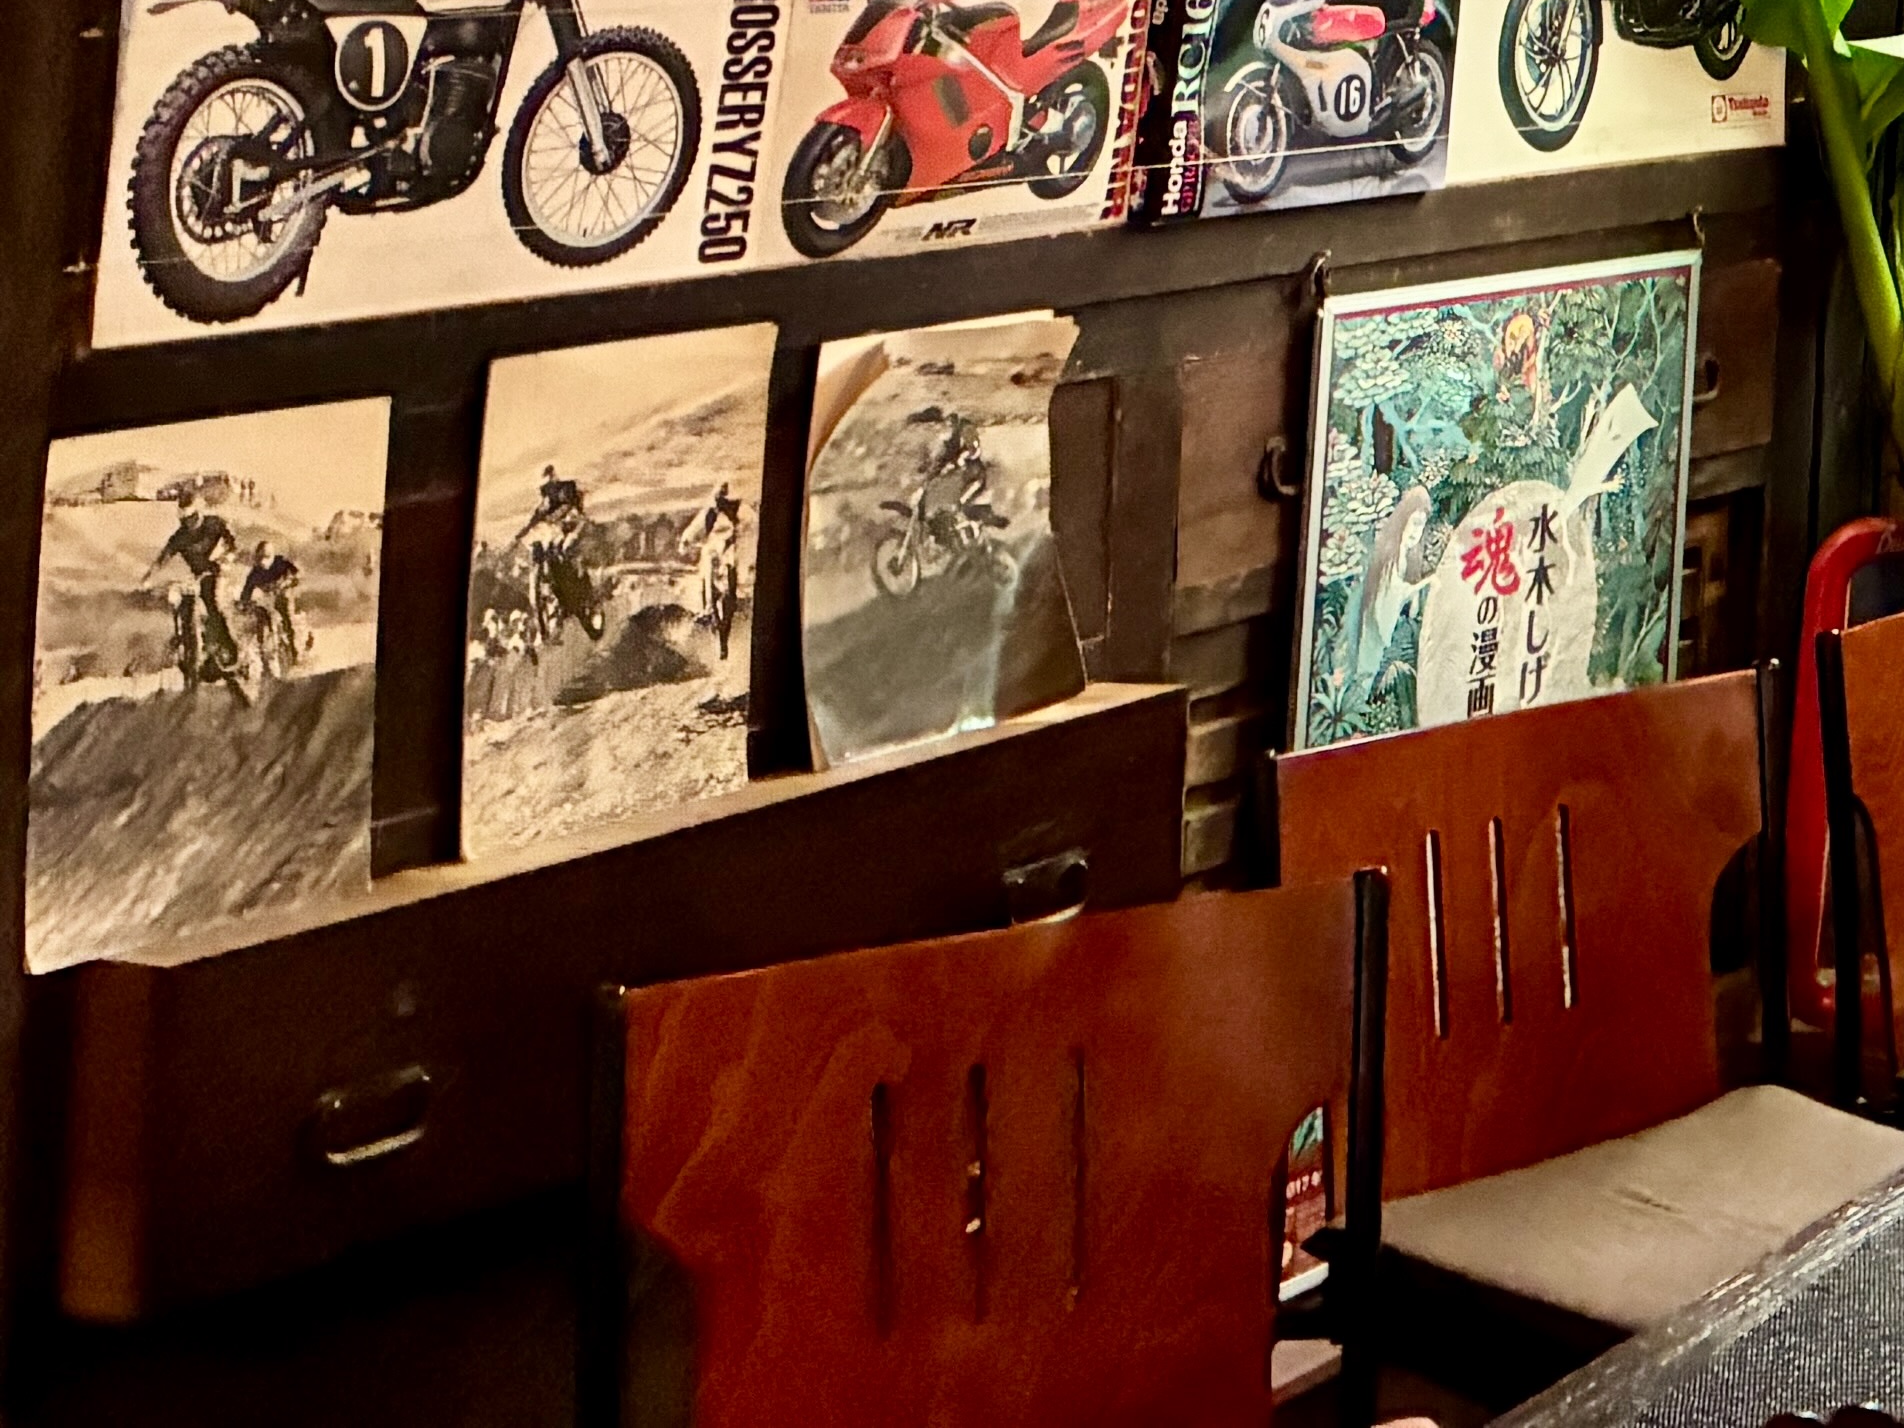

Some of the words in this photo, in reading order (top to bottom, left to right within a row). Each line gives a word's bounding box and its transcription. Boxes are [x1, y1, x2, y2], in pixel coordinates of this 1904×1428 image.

[364, 27, 389, 99] 1
[1339, 78, 1362, 116] 16
[697, 129, 763, 265] YZ250
[1160, 119, 1188, 216] Honda
[1460, 506, 1521, 719] 魂の漫画
